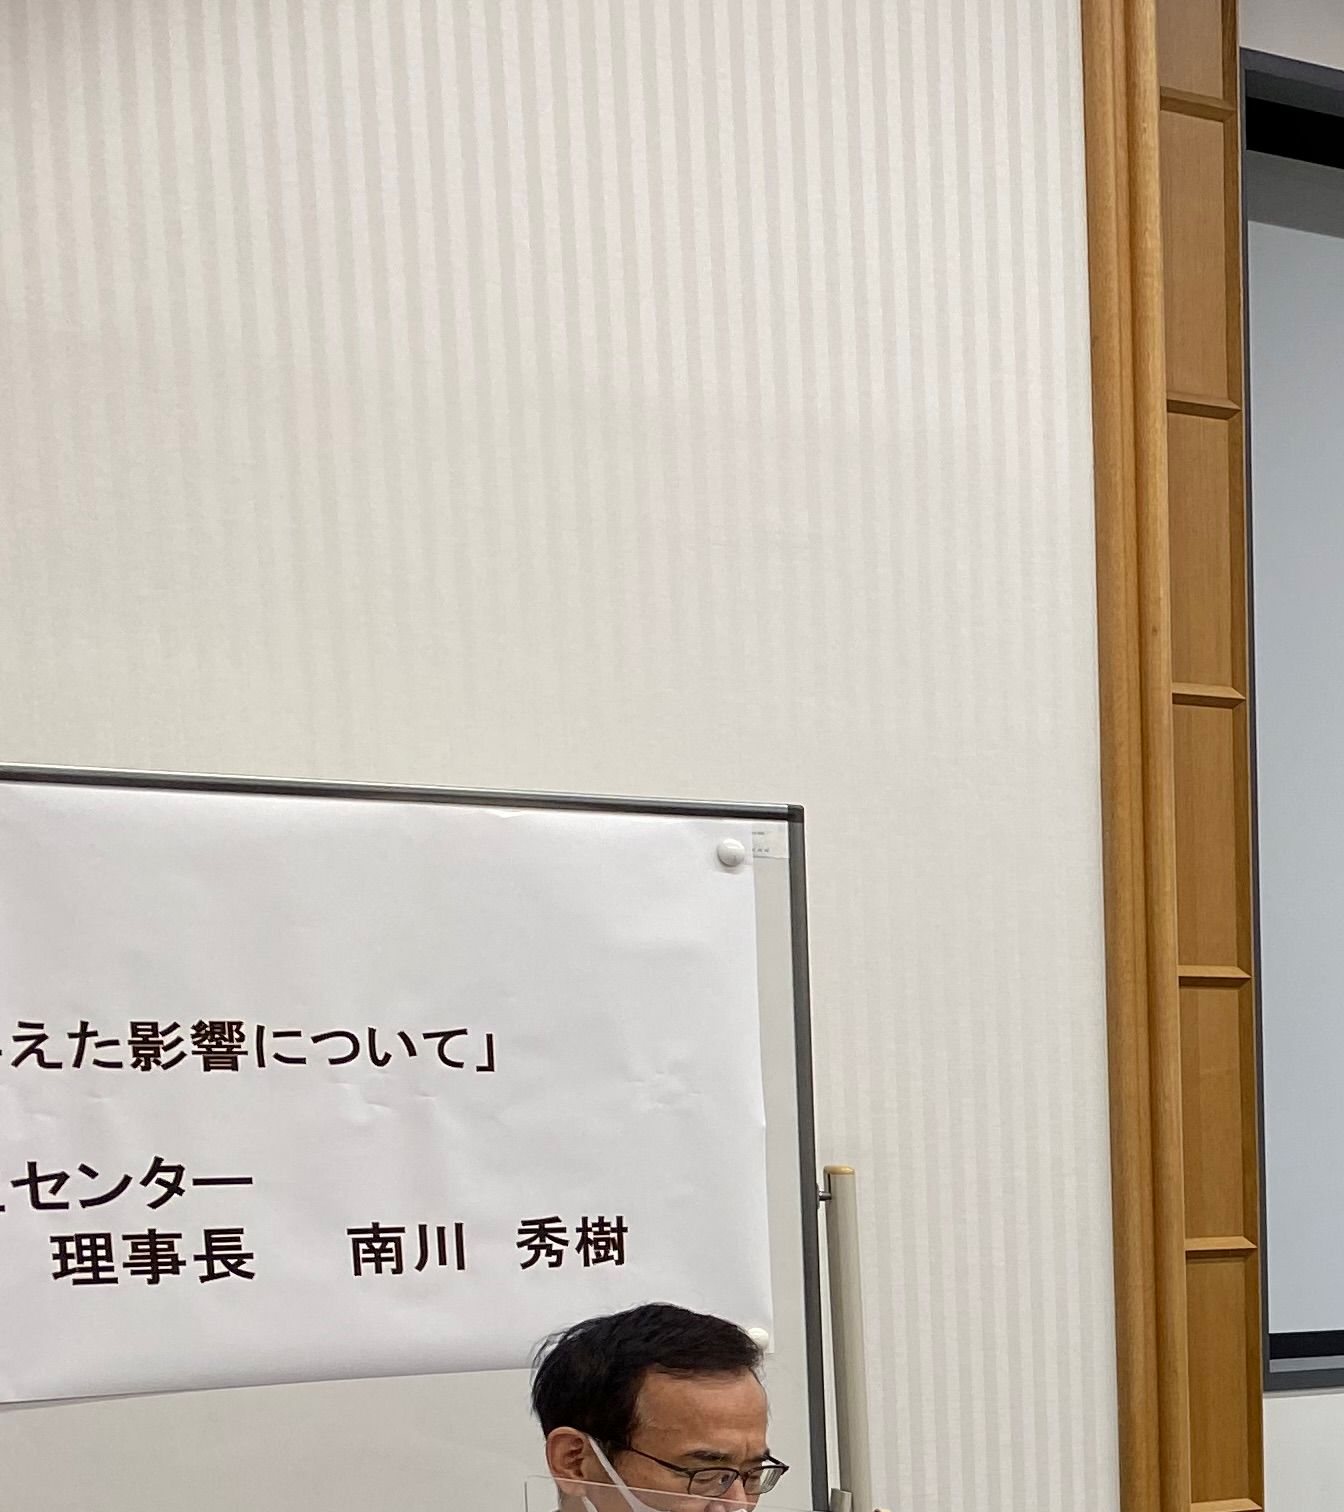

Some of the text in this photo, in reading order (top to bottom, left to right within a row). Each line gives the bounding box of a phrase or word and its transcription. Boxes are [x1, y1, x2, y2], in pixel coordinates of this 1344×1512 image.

[0, 1020, 497, 1073] えた影響について」
[0, 1156, 254, 1212] センター
[50, 1215, 629, 1287] 理事長 南川 秀樹
